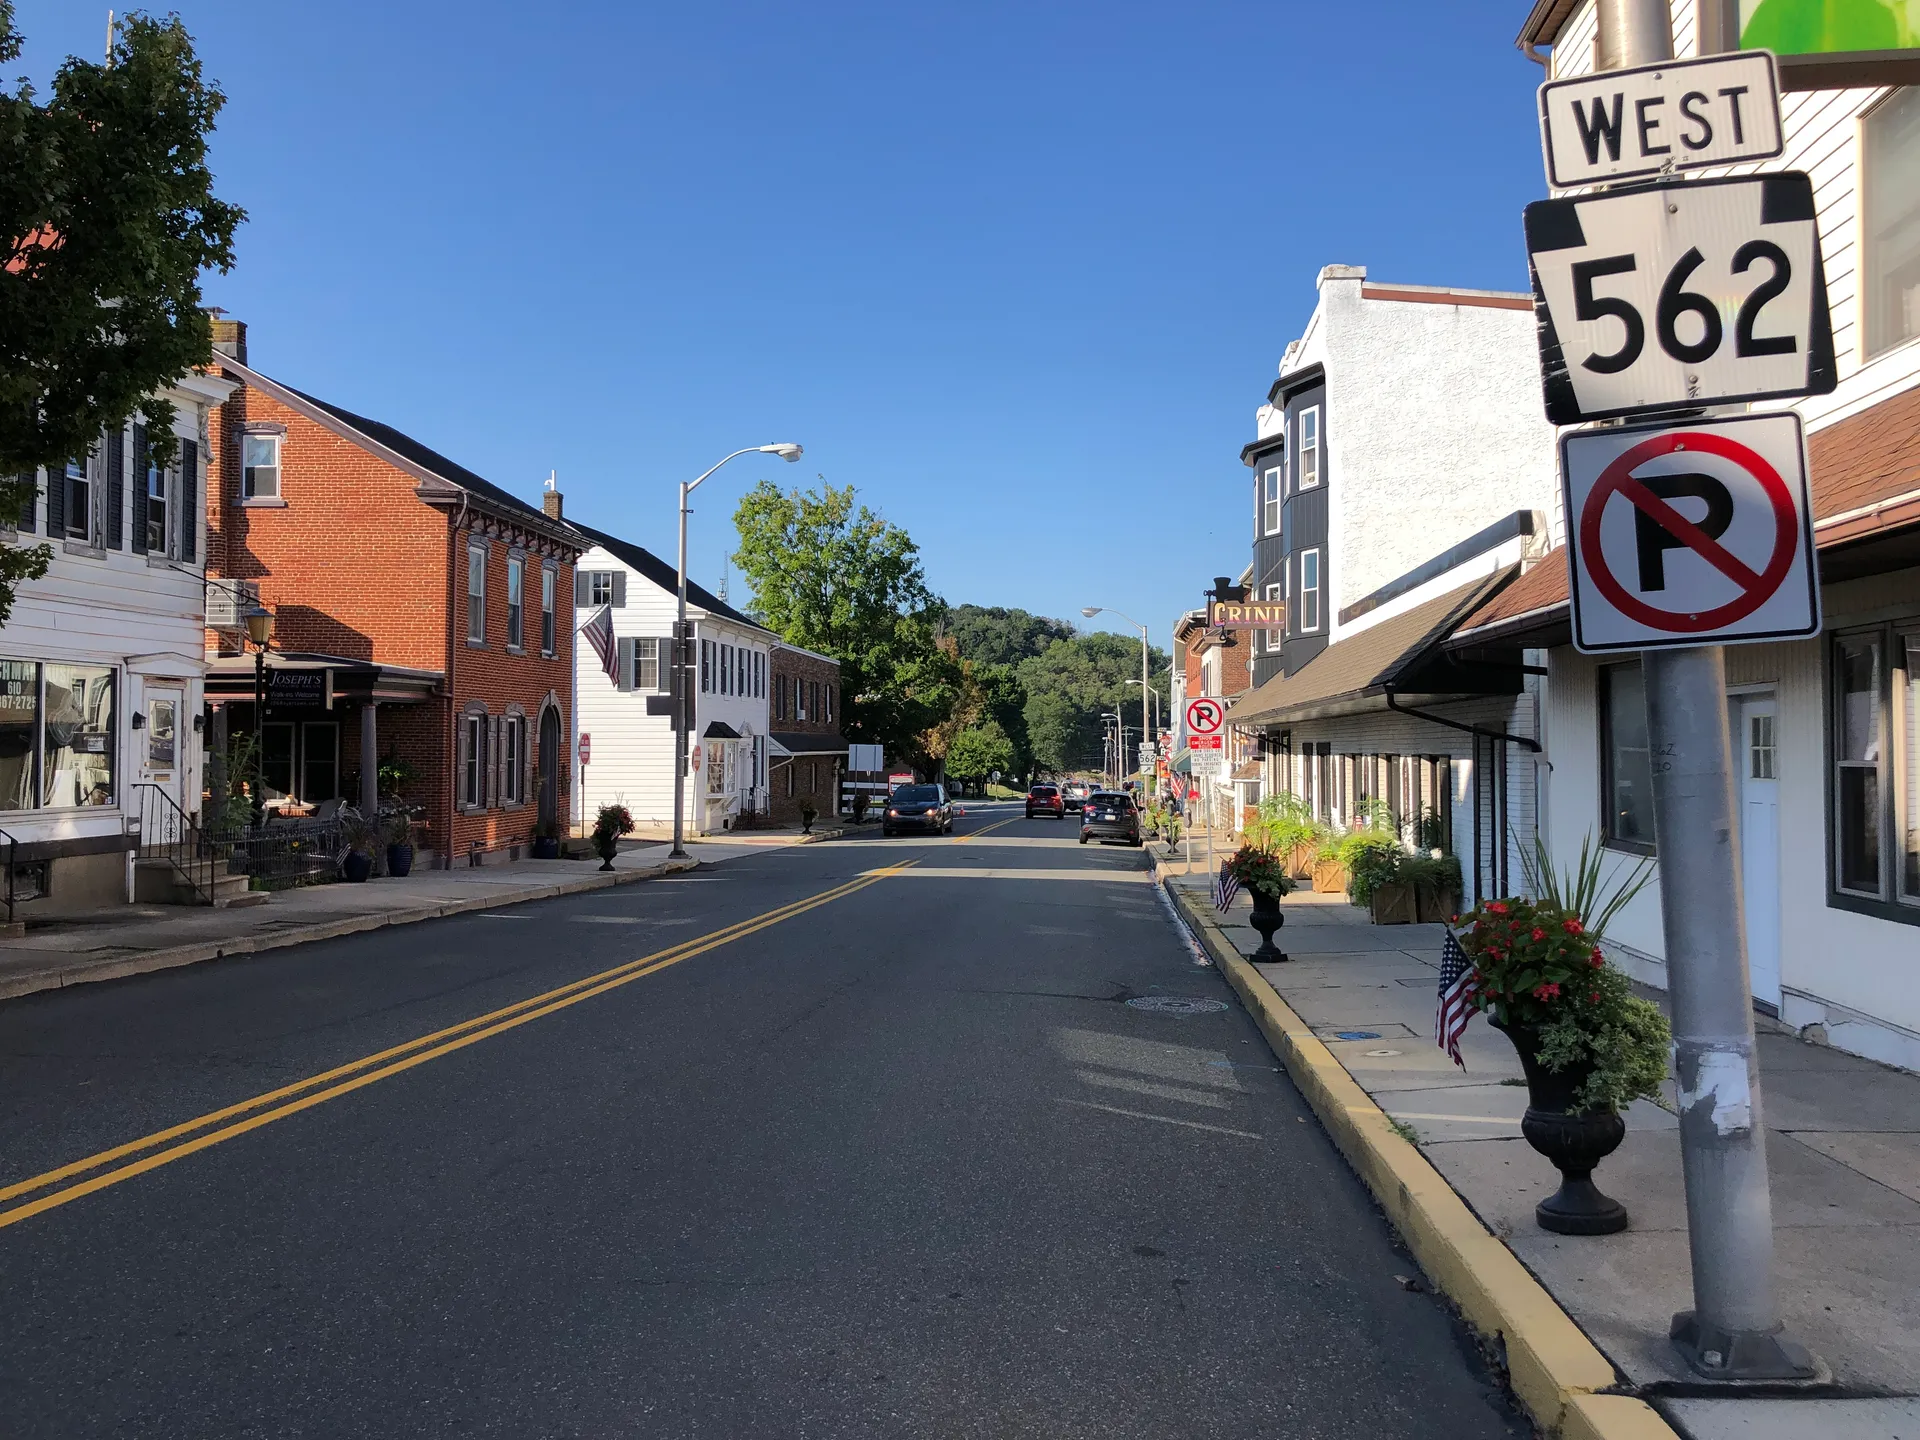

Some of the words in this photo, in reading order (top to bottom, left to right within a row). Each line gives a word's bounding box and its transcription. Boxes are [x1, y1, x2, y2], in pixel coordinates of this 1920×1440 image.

[1570, 84, 1749, 166] WEST
[1571, 239, 1797, 375] 562
[268, 670, 322, 687] JOSEPH'S
[7, 681, 22, 696] 610
[1139, 754, 1156, 763] 562
